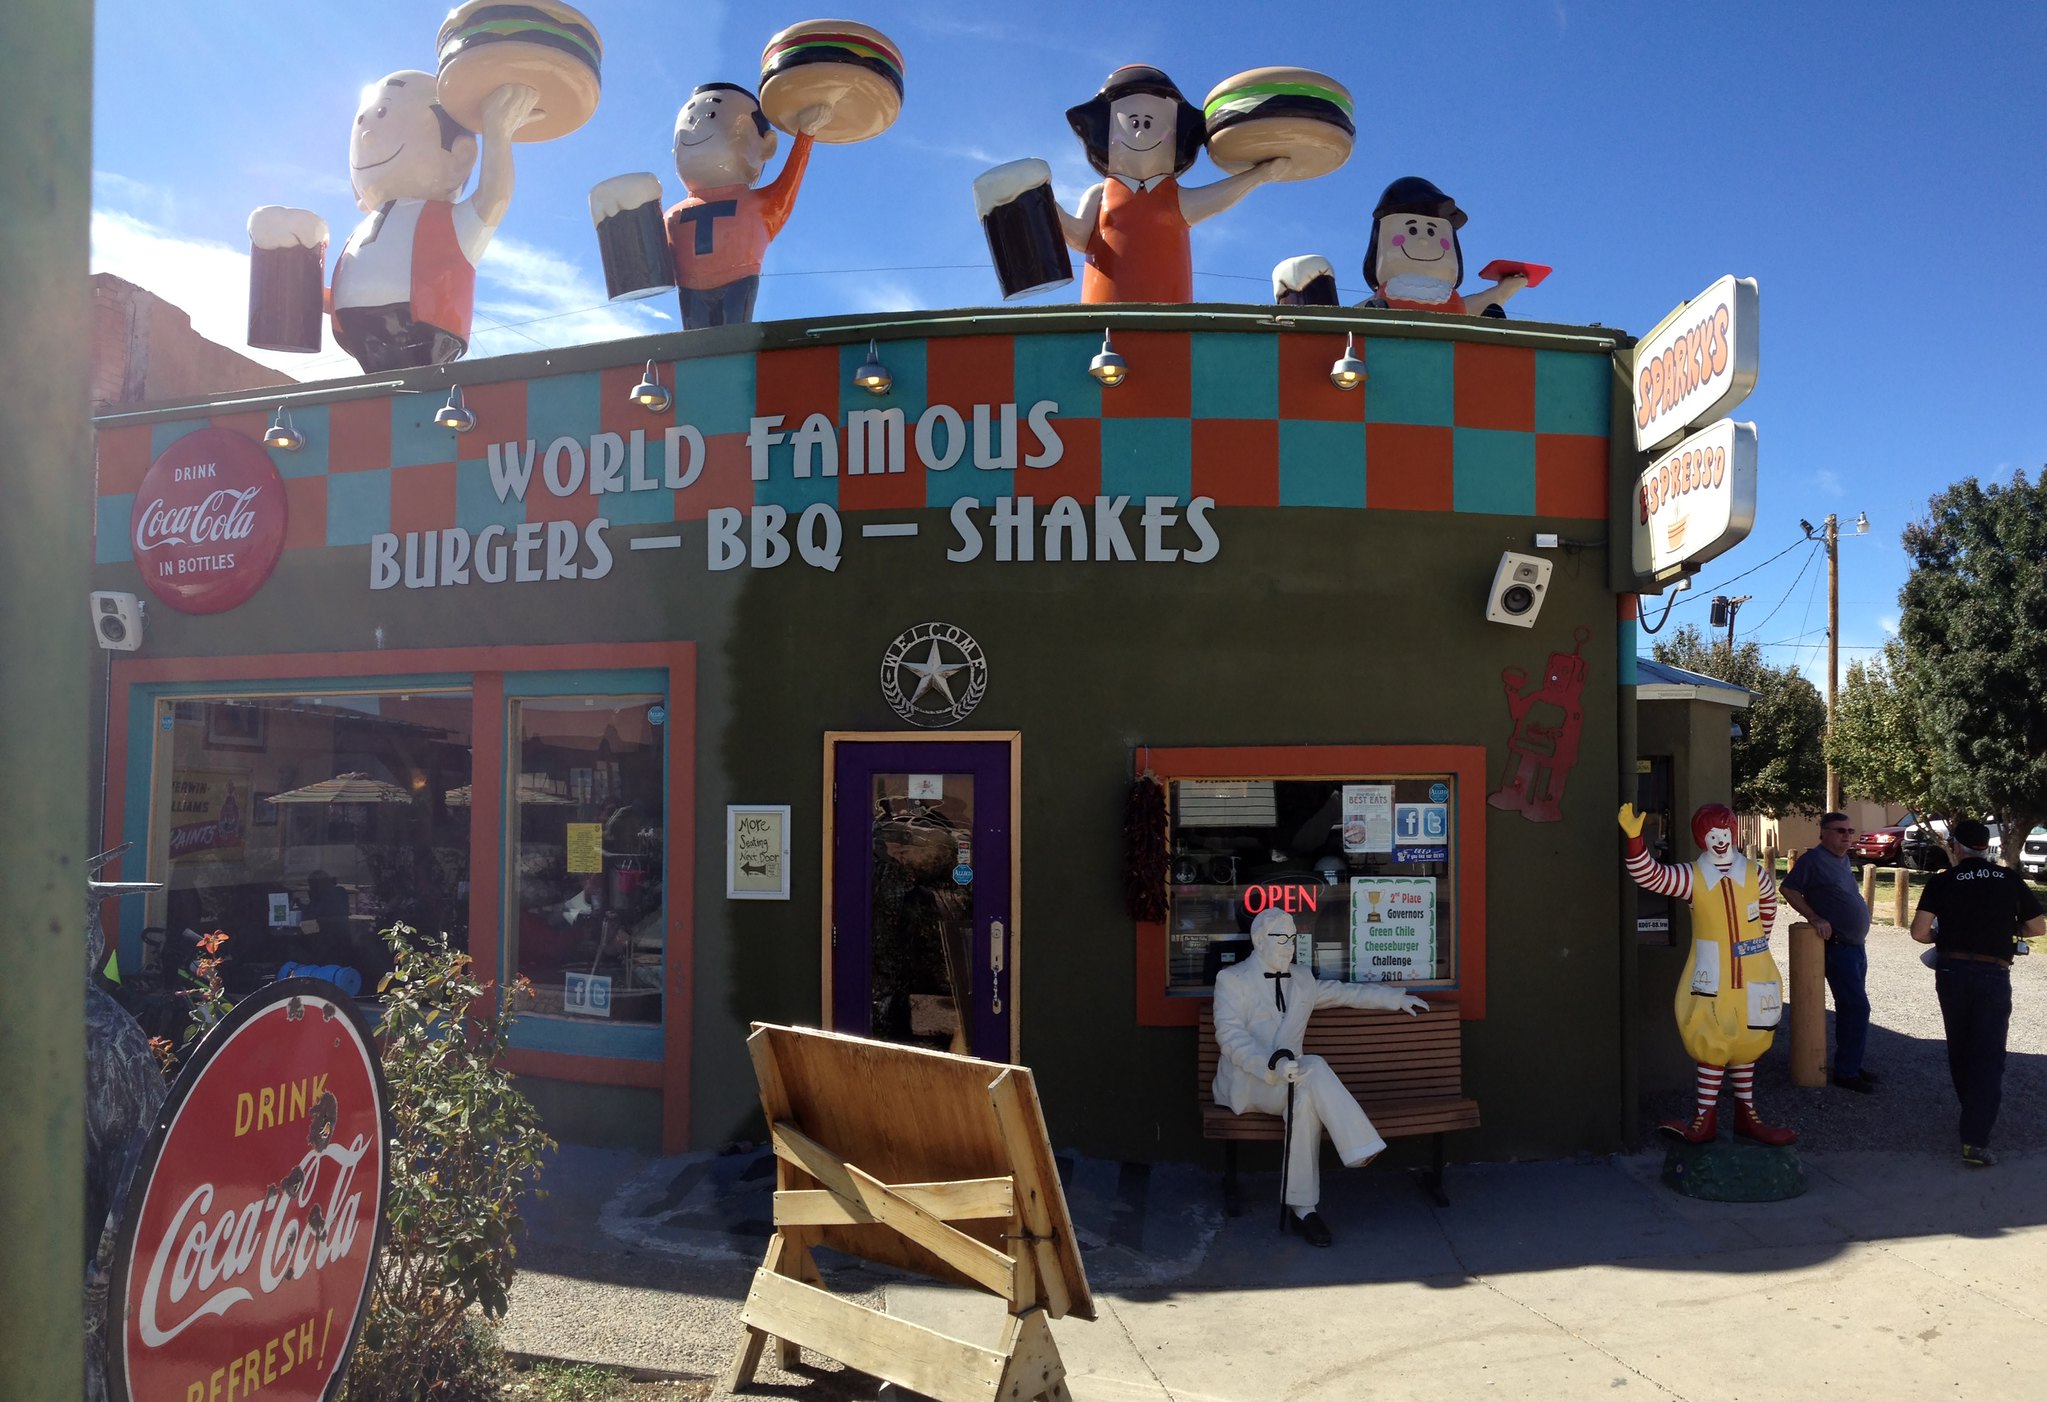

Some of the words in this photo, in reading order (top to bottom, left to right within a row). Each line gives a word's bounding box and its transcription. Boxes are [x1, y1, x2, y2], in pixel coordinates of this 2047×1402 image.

[680, 200, 737, 255] T
[1637, 303, 1729, 430] SPARKYS
[487, 424, 706, 503] WORLD
[746, 399, 1065, 481] FAMOUS
[174, 463, 217, 482] DRINK
[1639, 446, 1726, 525] ESPRESSO
[136, 486, 262, 551] Coca-Cola
[369, 518, 614, 590] BURGERS
[707, 503, 843, 572] BBQ
[947, 495, 1221, 564] SHAKES
[160, 560, 173, 576] IN
[178, 553, 235, 574] BOTTLES
[884, 623, 986, 670] WELCOME
[1348, 796, 1367, 804] BEST
[1369, 796, 1388, 804] EATS
[738, 817, 770, 835] More
[739, 834, 769, 854] Seating
[759, 852, 780, 862] Door
[1956, 870, 1975, 881] Got
[1976, 868, 1990, 879] 40
[1992, 870, 2005, 879] oz
[1244, 884, 1317, 914] OPEN
[1402, 892, 1422, 904] Place
[1387, 908, 1424, 919] Governors
[1369, 926, 1393, 937] Green
[1395, 926, 1415, 937] Chile
[1364, 941, 1419, 952] Cheeseburger
[1372, 955, 1412, 966] Challenge
[1381, 971, 1402, 982] 2010
[234, 1073, 329, 1137] DRINK
[139, 1133, 373, 1348] Coca-Cola
